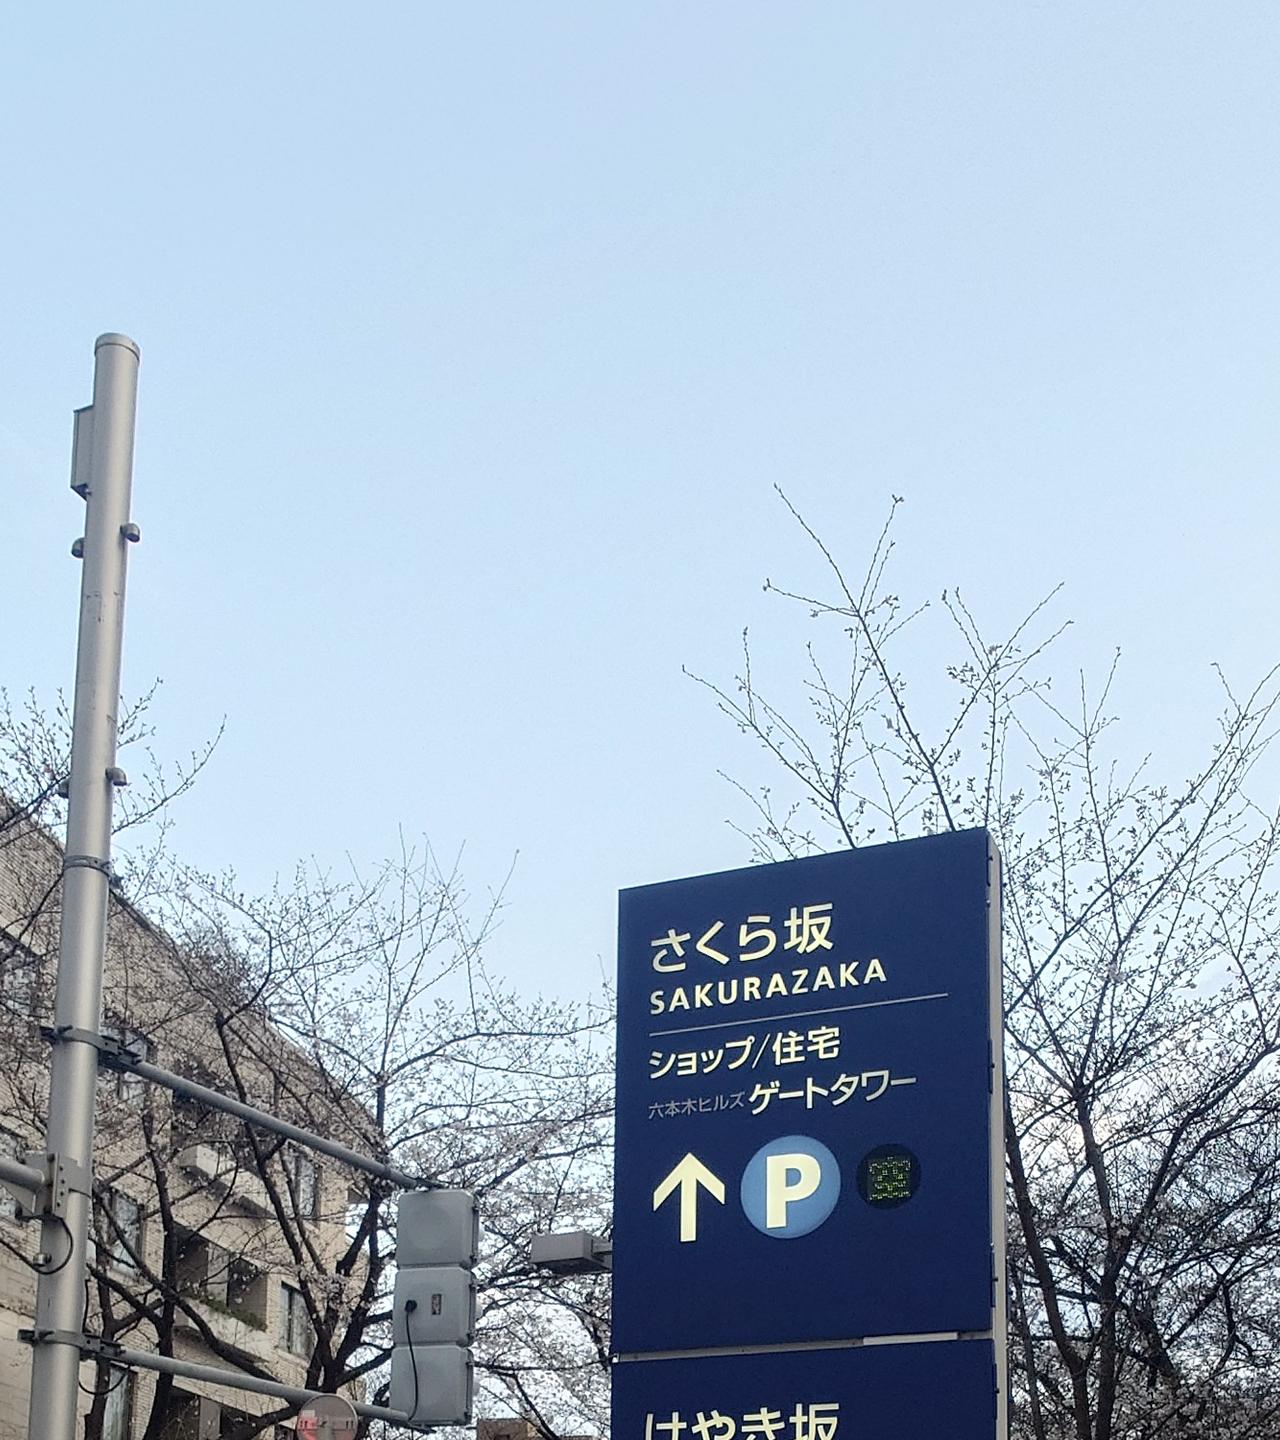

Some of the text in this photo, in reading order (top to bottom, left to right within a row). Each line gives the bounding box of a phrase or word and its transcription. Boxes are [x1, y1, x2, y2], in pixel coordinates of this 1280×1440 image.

[651, 902, 834, 973] さくら坂
[649, 957, 888, 1015] SAKURAZAKA
[648, 1026, 841, 1080] ショップ/住宅
[766, 1152, 822, 1229] P
